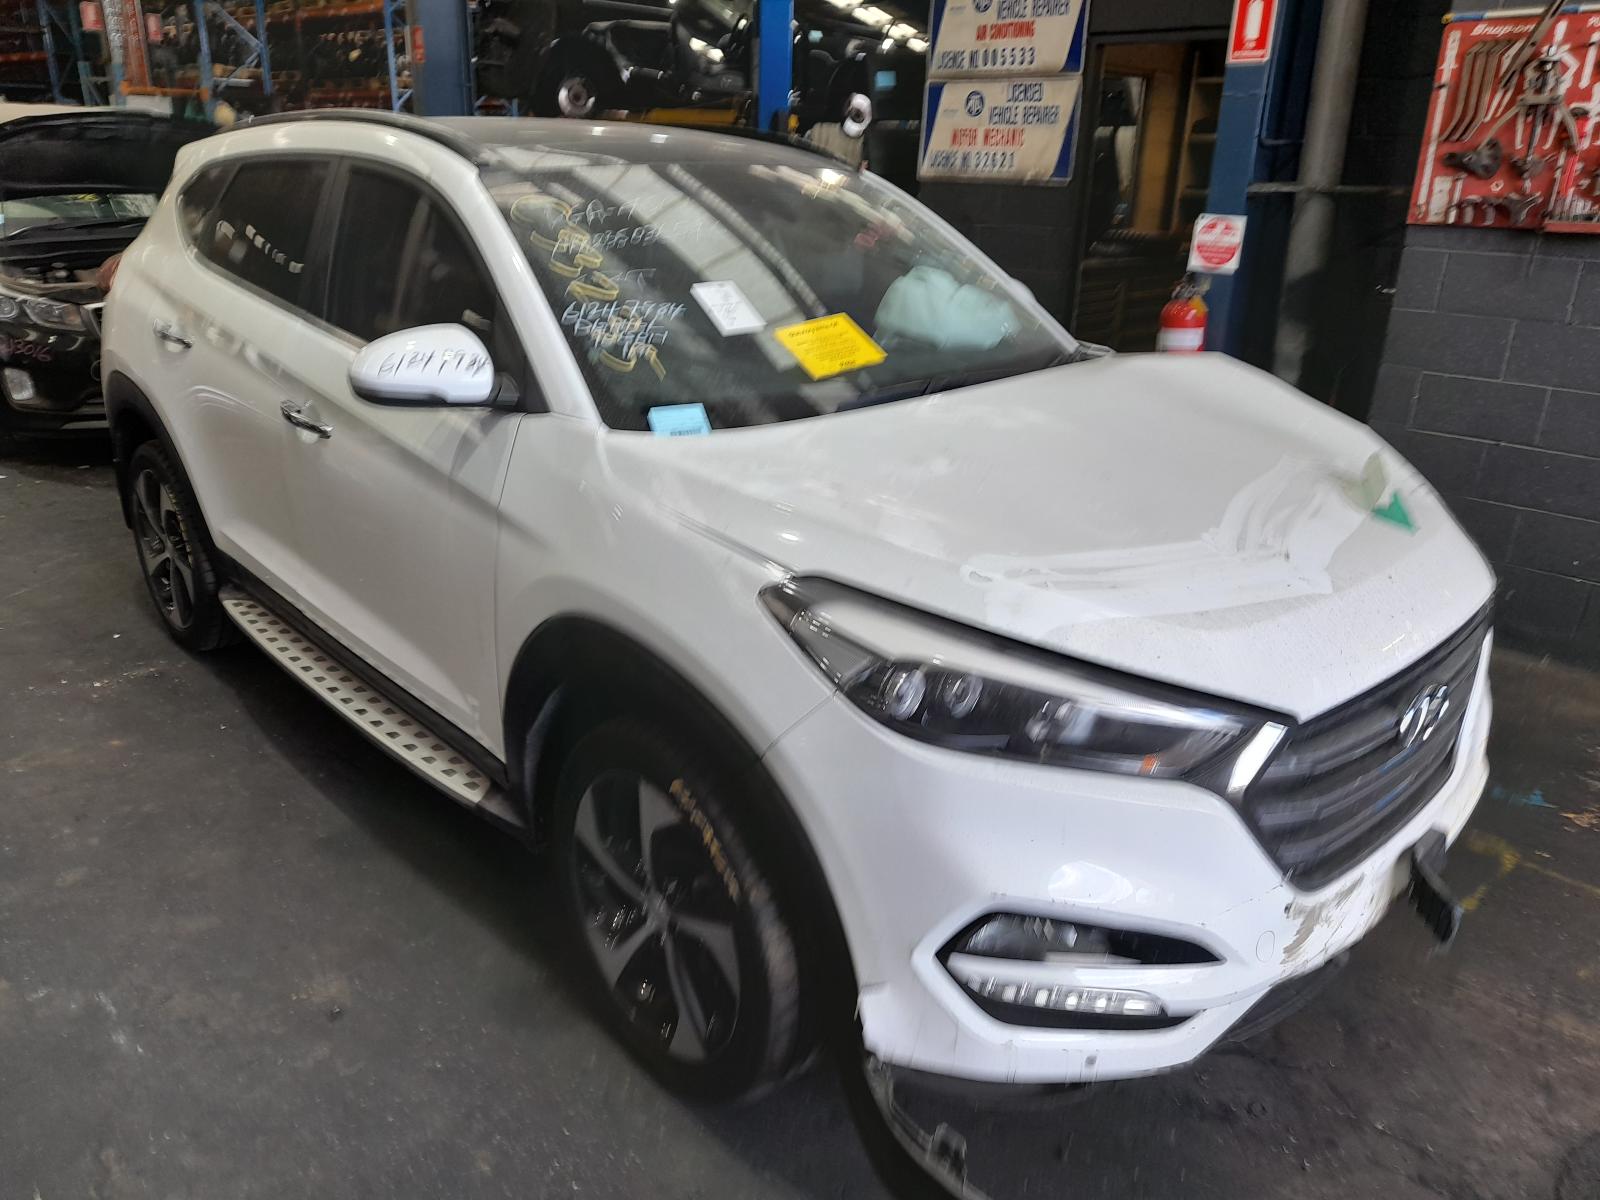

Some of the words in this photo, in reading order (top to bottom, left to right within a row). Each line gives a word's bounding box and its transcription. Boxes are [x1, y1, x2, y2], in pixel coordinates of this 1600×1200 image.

[976, 23, 987, 41] AIR
[990, 20, 1036, 40] CONDITIONING
[988, 106, 1018, 125] VEHICLE
[1022, 105, 1060, 124] REPAIRER
[951, 128, 978, 146] MOTOR
[983, 127, 1025, 147] MECHANIC
